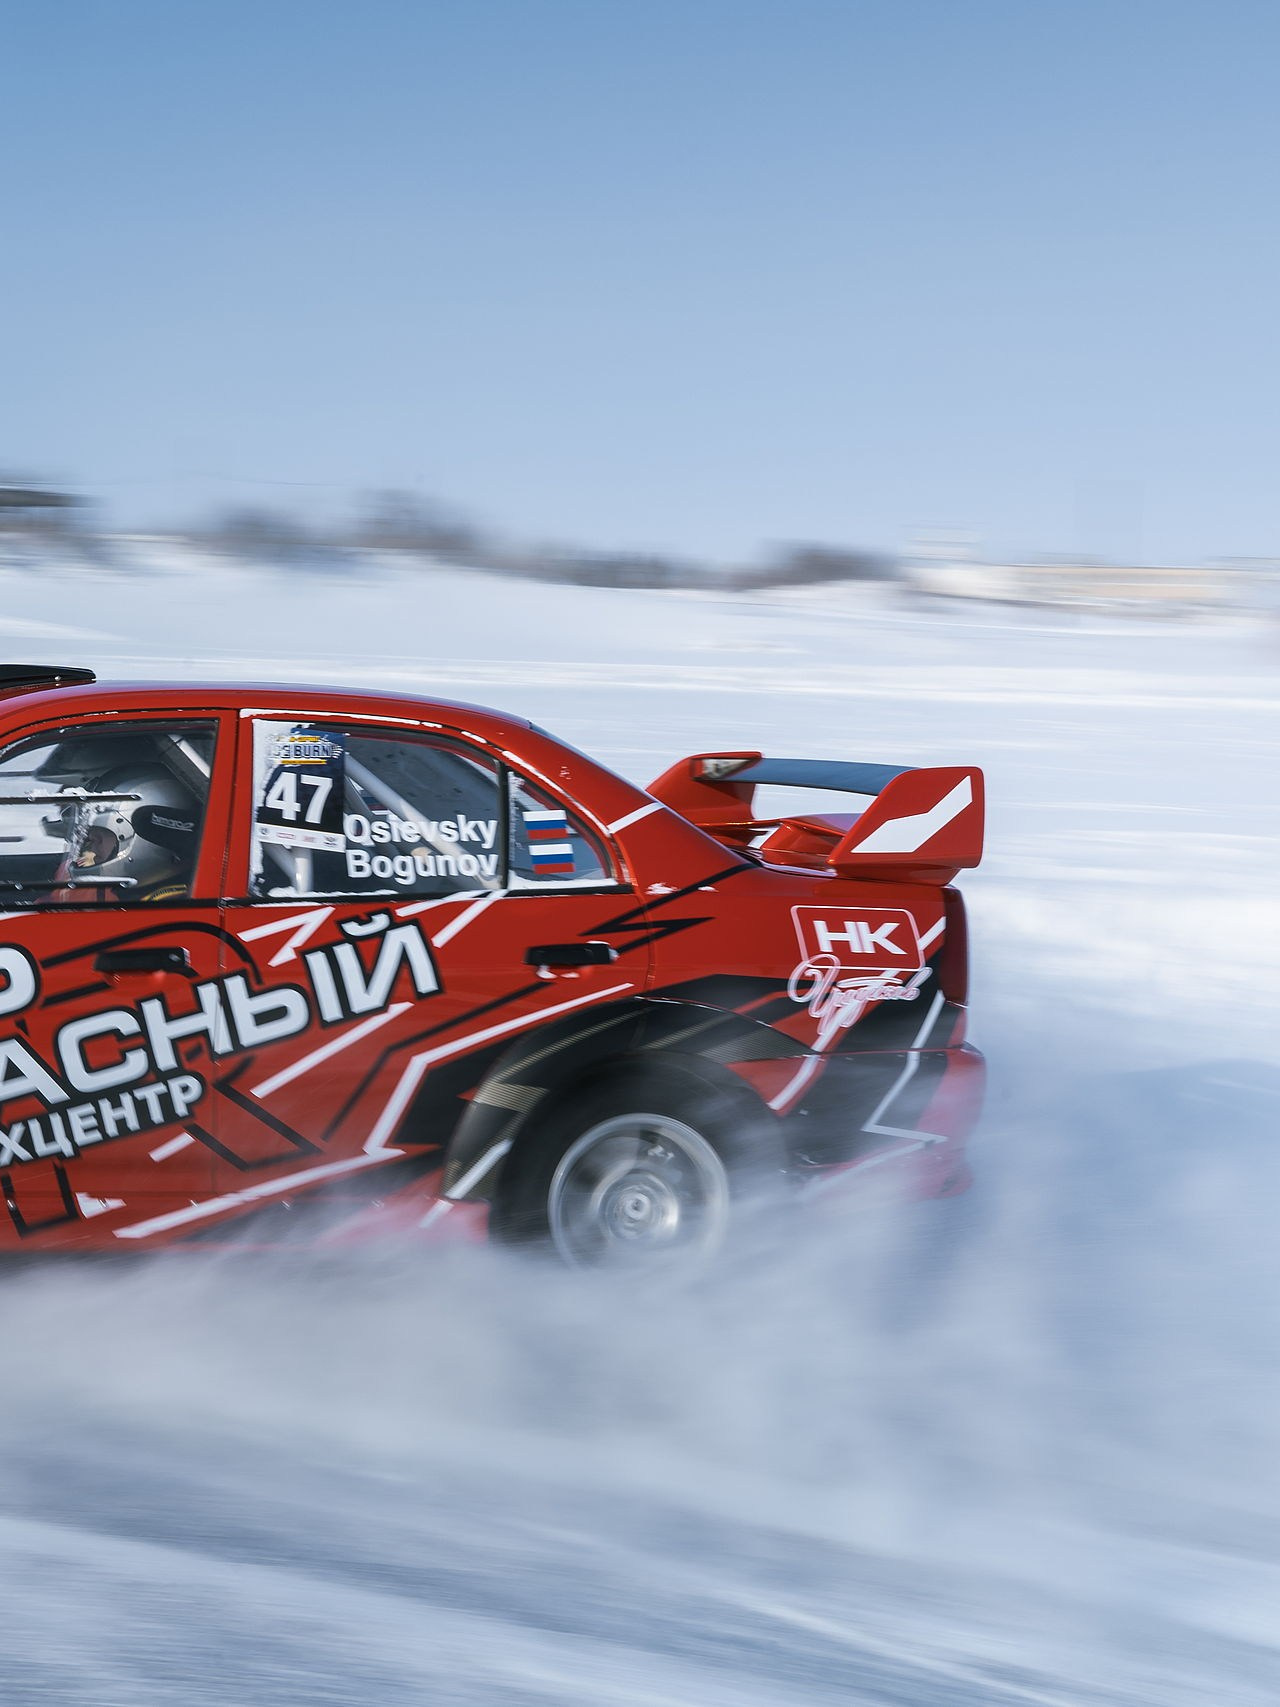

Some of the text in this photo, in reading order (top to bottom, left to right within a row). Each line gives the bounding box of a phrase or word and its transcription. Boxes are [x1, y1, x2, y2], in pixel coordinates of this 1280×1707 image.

[294, 744, 332, 758] BURN
[265, 771, 333, 824] 47
[344, 814, 498, 849] Osievsky
[346, 849, 498, 885] Bogunov
